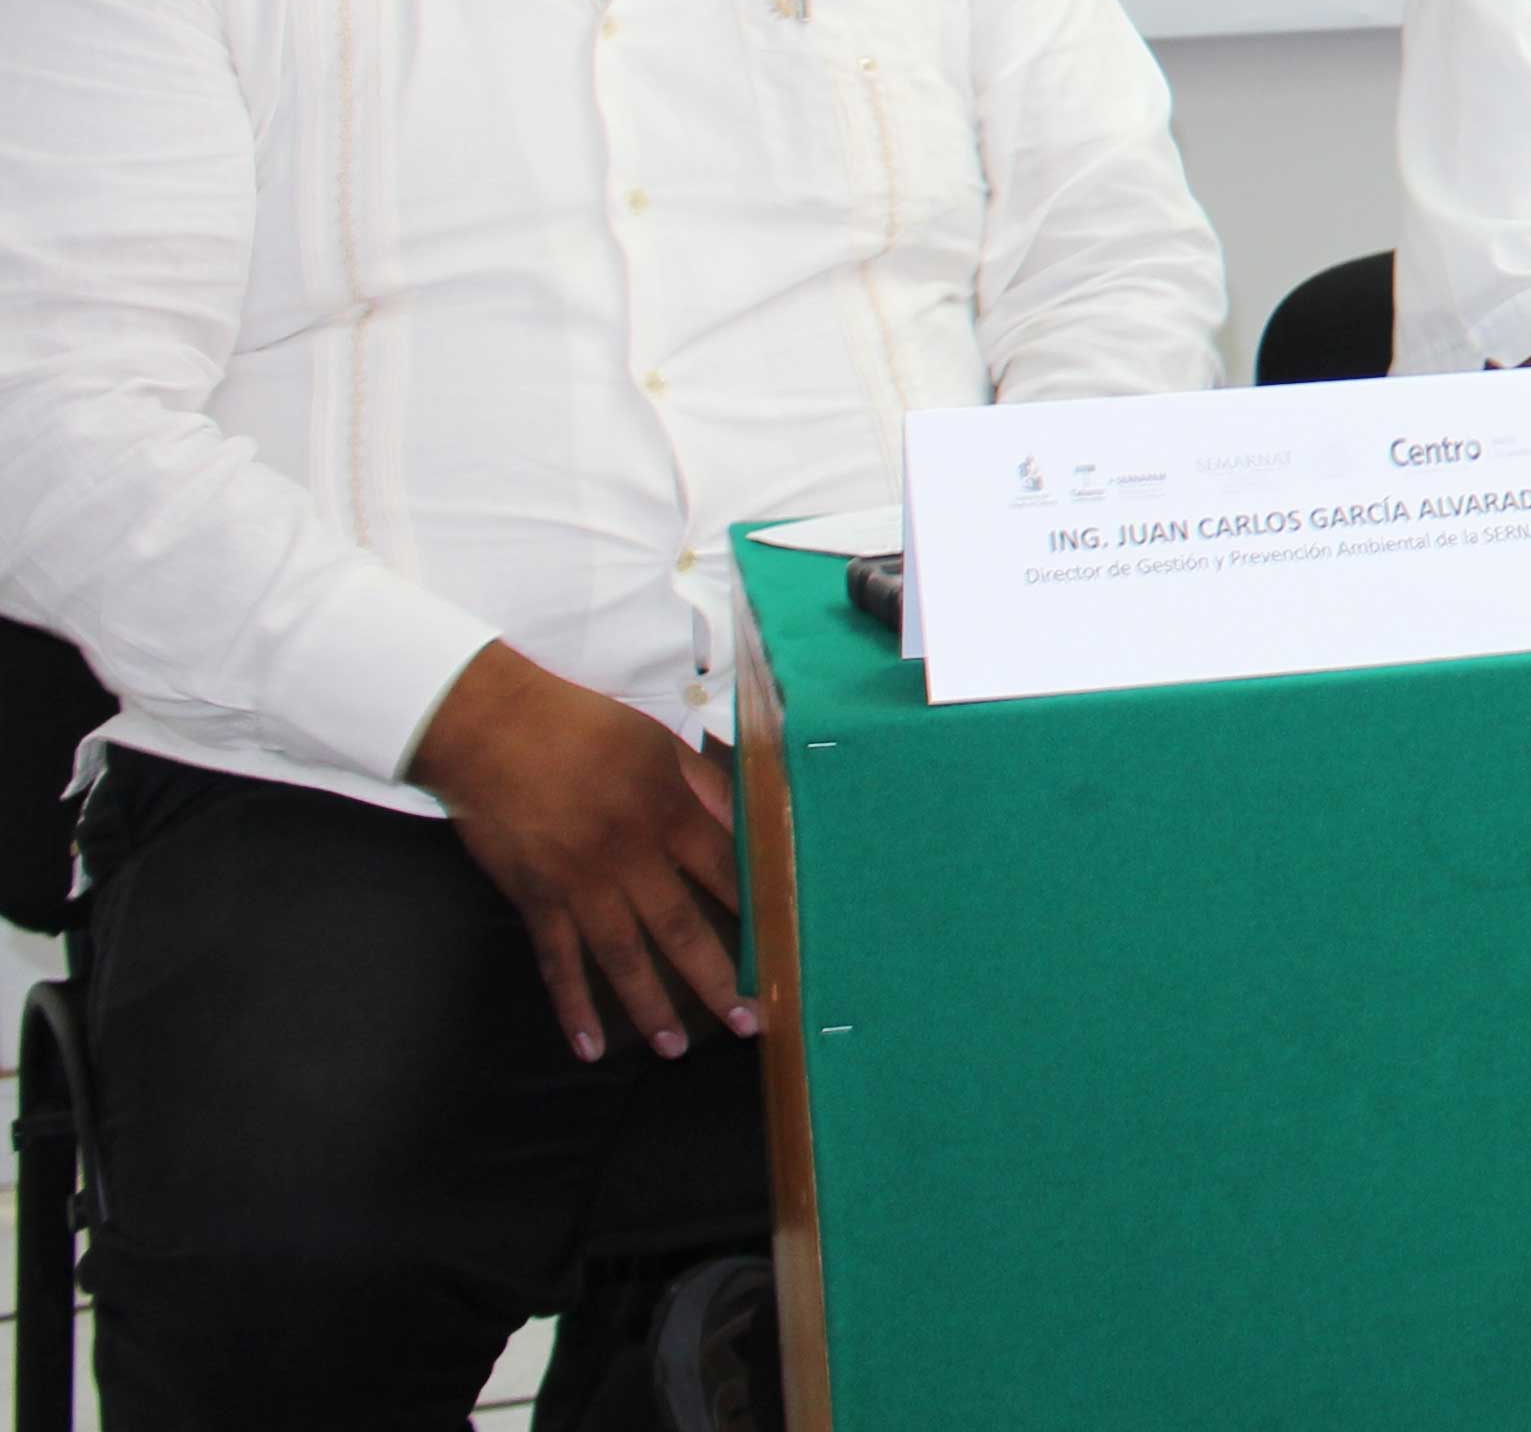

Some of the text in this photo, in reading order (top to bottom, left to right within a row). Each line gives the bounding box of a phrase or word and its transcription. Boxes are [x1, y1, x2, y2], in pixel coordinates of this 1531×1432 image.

[1389, 436, 1482, 468] Centro
[1049, 528, 1108, 554] ING.
[1116, 519, 1190, 548] JUAN
[1198, 508, 1303, 540] CARLOS
[1309, 497, 1412, 532] GARCÍA
[1024, 563, 1102, 586] Director
[1107, 559, 1131, 578] de
[1136, 552, 1209, 576] Gestión
[1213, 554, 1225, 572] y
[1230, 542, 1332, 568] Prevención
[1336, 533, 1431, 559] Ambiental
[1436, 529, 1459, 549] de
[1461, 526, 1479, 547] la
